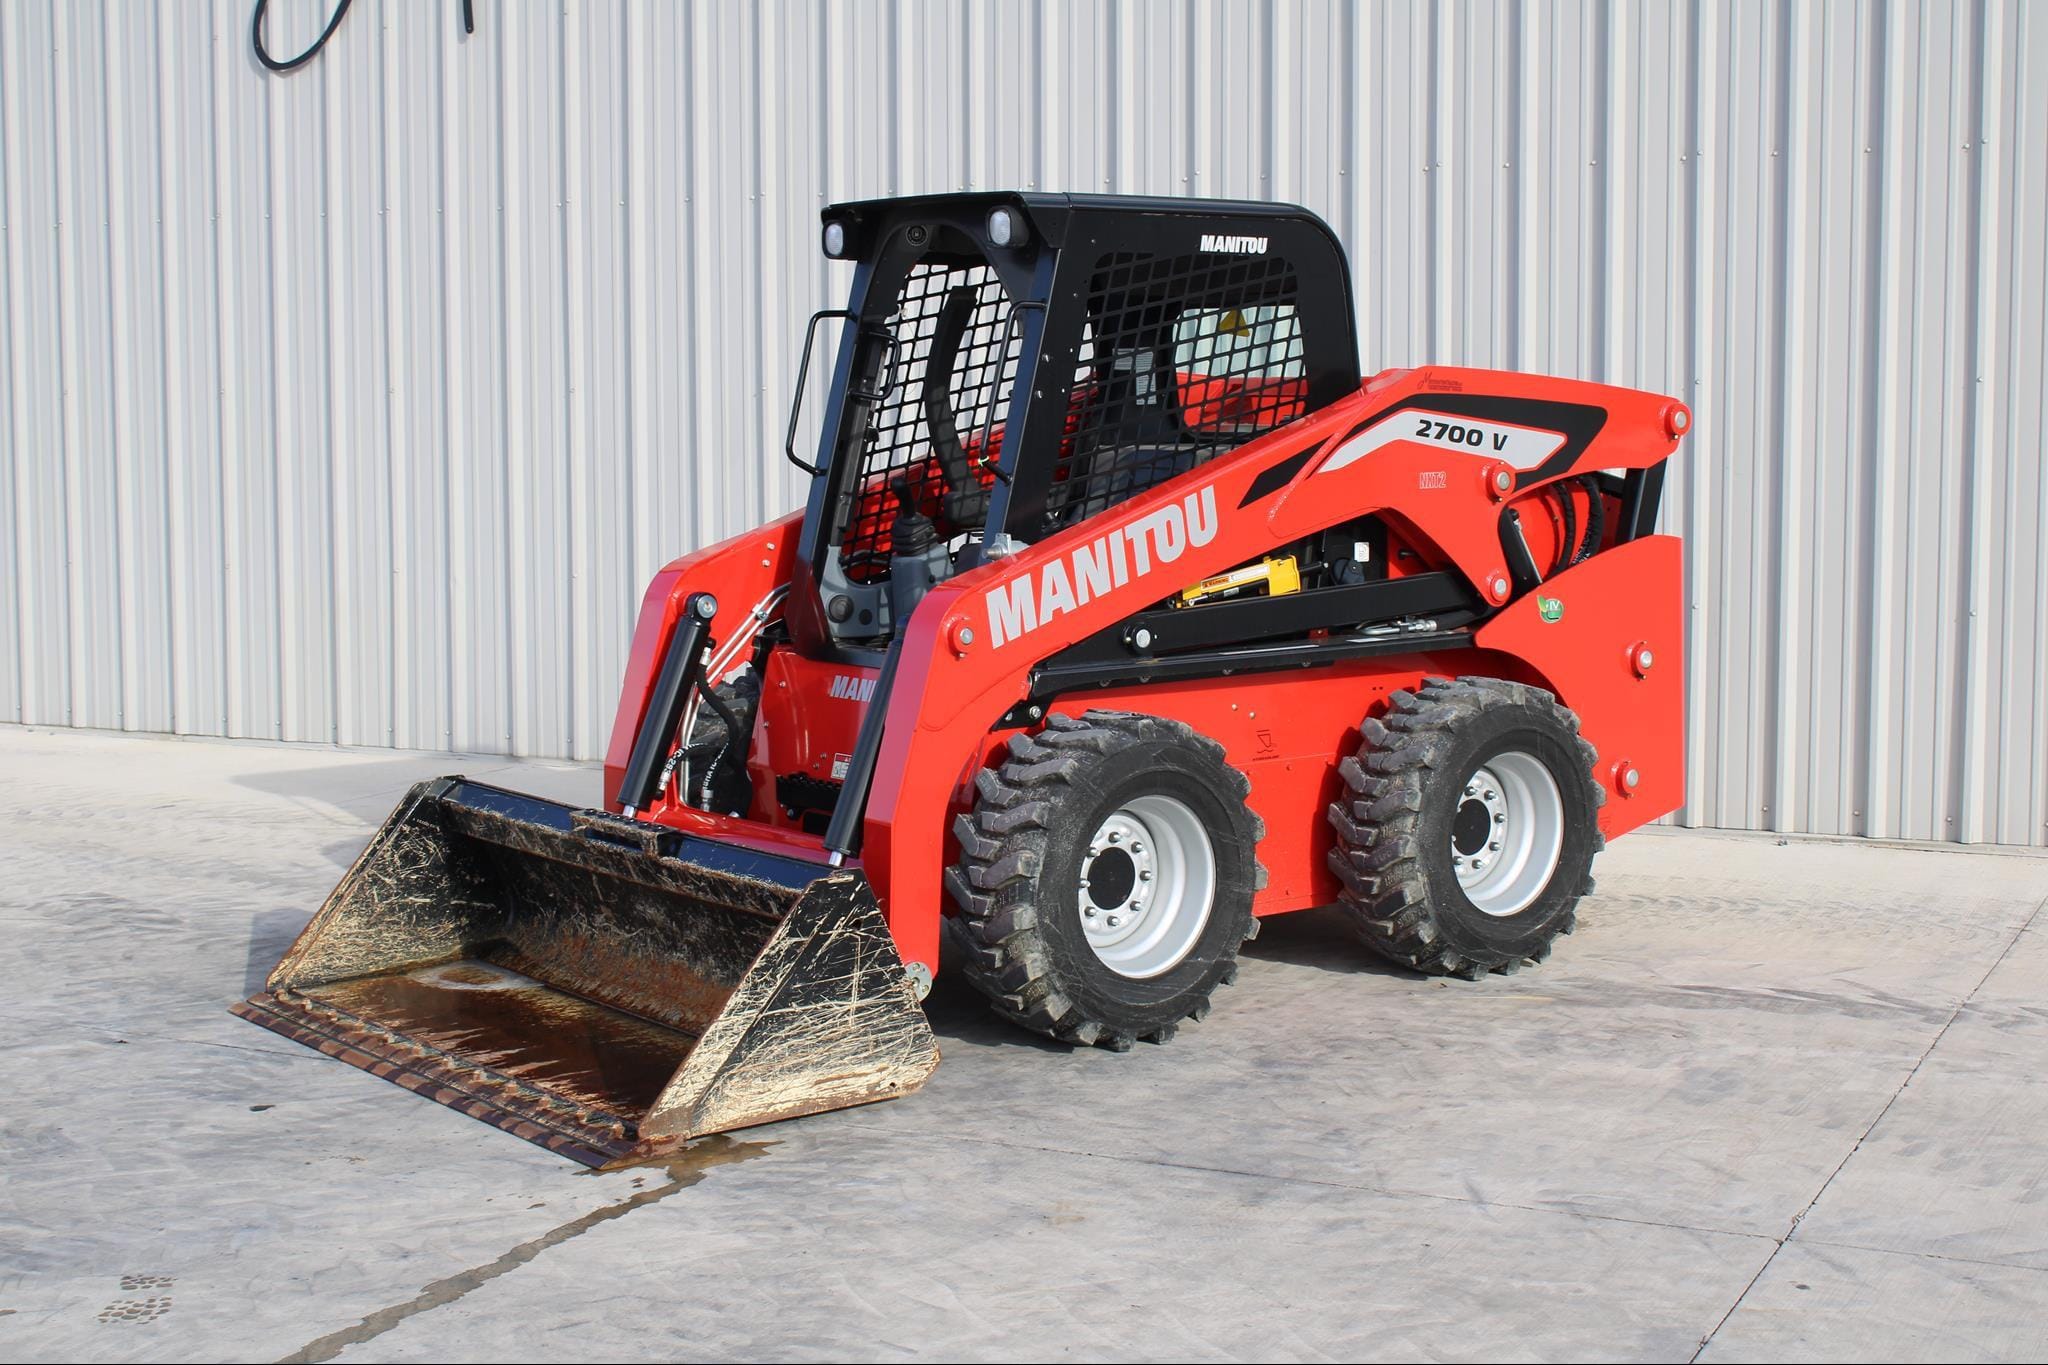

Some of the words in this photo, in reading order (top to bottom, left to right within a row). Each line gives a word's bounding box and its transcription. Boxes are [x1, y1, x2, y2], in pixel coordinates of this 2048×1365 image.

[1199, 235, 1268, 254] MANITOU
[1416, 419, 1483, 446] 2700
[1493, 433, 1508, 451] V
[985, 485, 1218, 650] MANITOU
